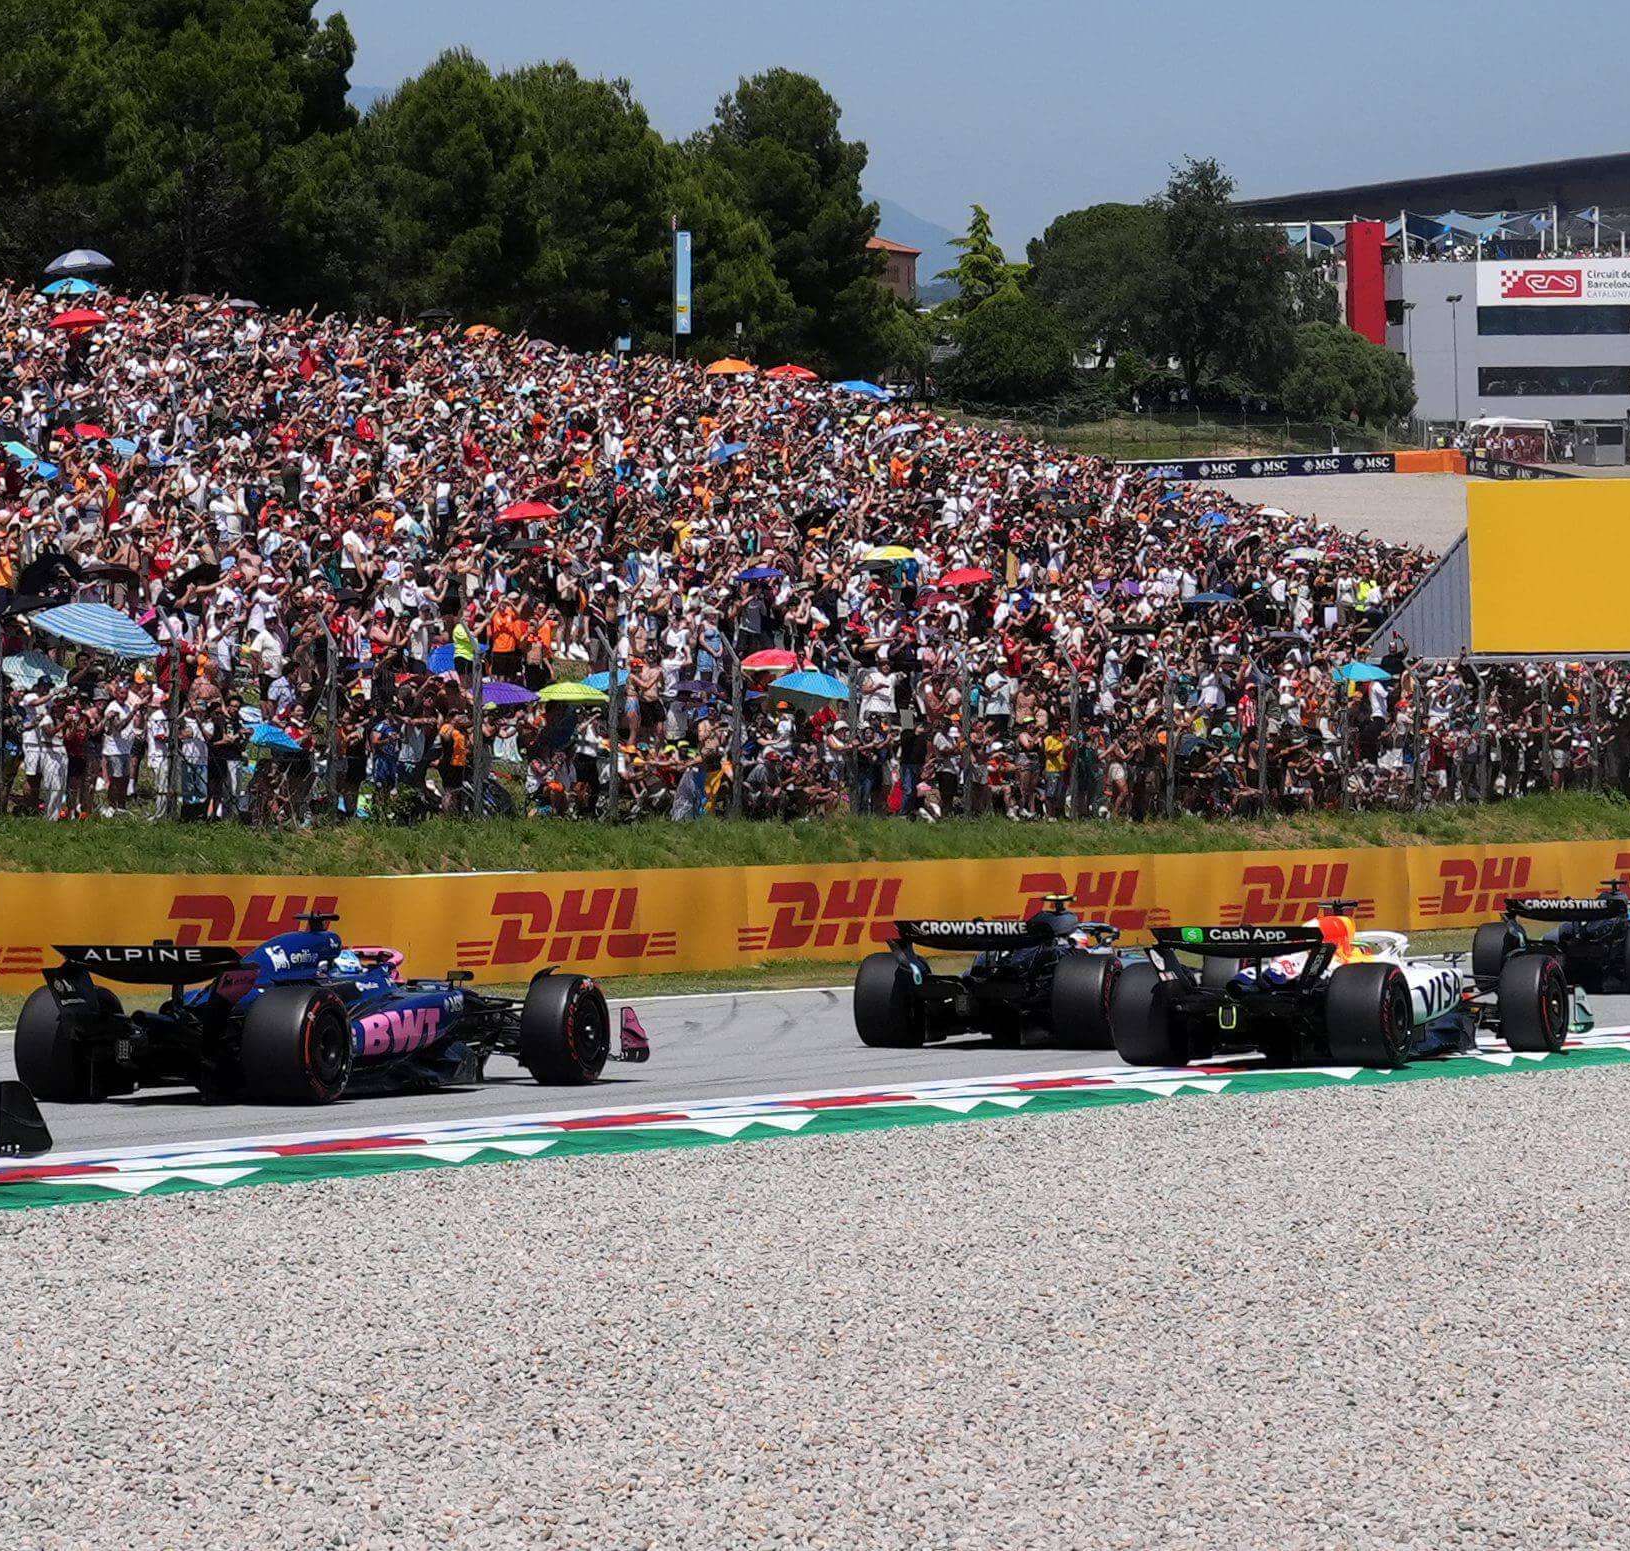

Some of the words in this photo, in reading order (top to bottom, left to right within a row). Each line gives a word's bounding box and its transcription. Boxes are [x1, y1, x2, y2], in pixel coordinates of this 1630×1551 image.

[1587, 270, 1619, 279] Circuit
[1211, 463, 1237, 474] MSC
[1263, 461, 1289, 472] MSC
[1315, 458, 1340, 469] MSC
[1366, 456, 1390, 468] MSC
[1524, 899, 1608, 910] CROWDSTRIKE
[491, 887, 646, 965] DHL
[920, 921, 1028, 935] CROWDSTRIKE
[1209, 928, 1250, 941] Cash
[1253, 929, 1286, 942] App
[84, 948, 203, 963] ALPINE
[1411, 969, 1461, 1017] VISA
[360, 1007, 440, 1056] BWT
